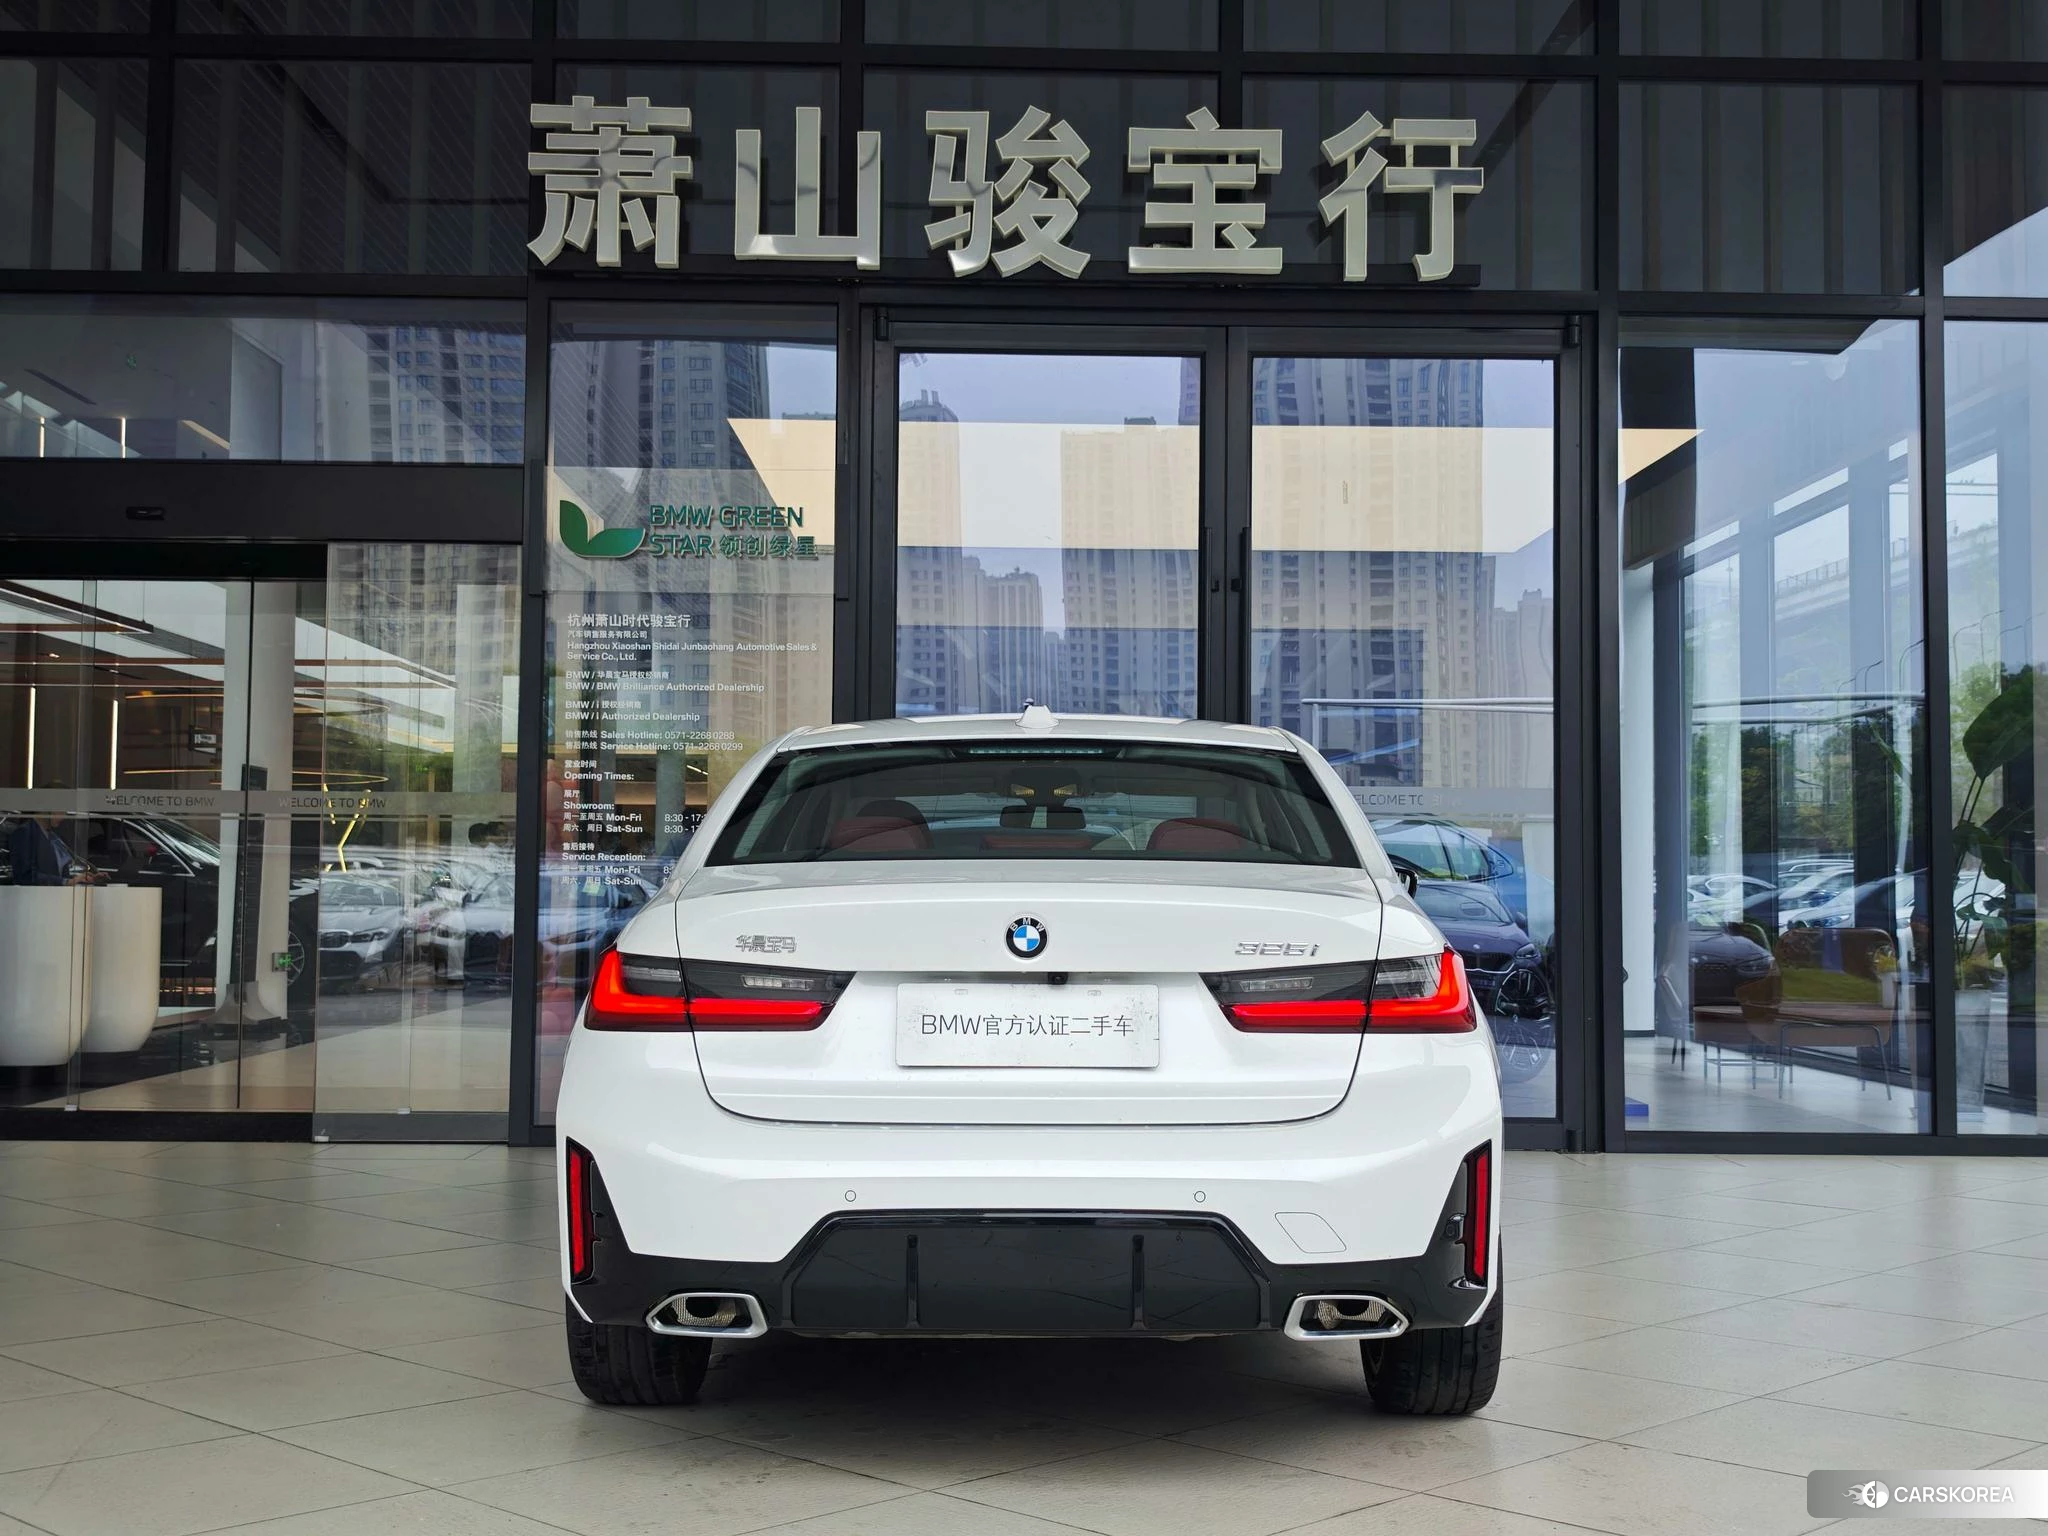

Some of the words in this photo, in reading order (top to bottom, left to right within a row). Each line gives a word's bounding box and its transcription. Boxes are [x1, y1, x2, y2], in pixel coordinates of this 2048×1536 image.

[528, 95, 1485, 282] 萧山骏宝行
[650, 504, 713, 527] BMW
[719, 505, 804, 529] GREEN
[650, 534, 714, 558] STAR
[719, 535, 818, 560] 领创绿星
[567, 613, 692, 628] 杭州萧山时代骏宝行
[567, 641, 610, 652] Hangzhou
[612, 642, 651, 651] Xiaoshan
[653, 642, 680, 651] Shidai
[681, 642, 734, 652] Junbaohang
[736, 643, 786, 651] Automotive
[786, 643, 810, 651] Sales
[567, 652, 600, 661] Service
[620, 652, 637, 661] Ltd.
[565, 671, 590, 679] BMW
[565, 682, 590, 690] BMW
[597, 682, 620, 690] BMW
[623, 682, 665, 691] Brilliance
[666, 683, 715, 691] Authorized
[717, 683, 765, 693] Dealership
[565, 700, 590, 709] BMW
[565, 711, 590, 720] BMW
[601, 711, 651, 720] Authorized
[652, 712, 700, 722] Dealership
[600, 730, 625, 739] Sales
[627, 730, 663, 739] Hotline:
[600, 741, 635, 750] Service
[636, 742, 671, 750] Hotline:
[564, 771, 602, 781] Opening
[604, 771, 635, 780] Times:
[165, 796, 182, 806] TO
[185, 796, 216, 807] BMW
[340, 798, 355, 808] TO
[1353, 794, 1407, 806] ELCOME
[563, 801, 615, 810] Showroom:
[606, 813, 642, 822] Mon-Fri
[664, 813, 683, 822] 8:30
[606, 824, 643, 833] Sat-Sun
[664, 825, 683, 833] 8:30
[561, 852, 596, 861] Service
[597, 853, 646, 862] Reception:
[604, 865, 641, 874] Mon-Fri
[604, 876, 642, 885] Sat-Sun
[1009, 917, 1045, 932] BMW
[735, 934, 797, 954] 华晨宝马
[1235, 941, 1320, 957] 325i
